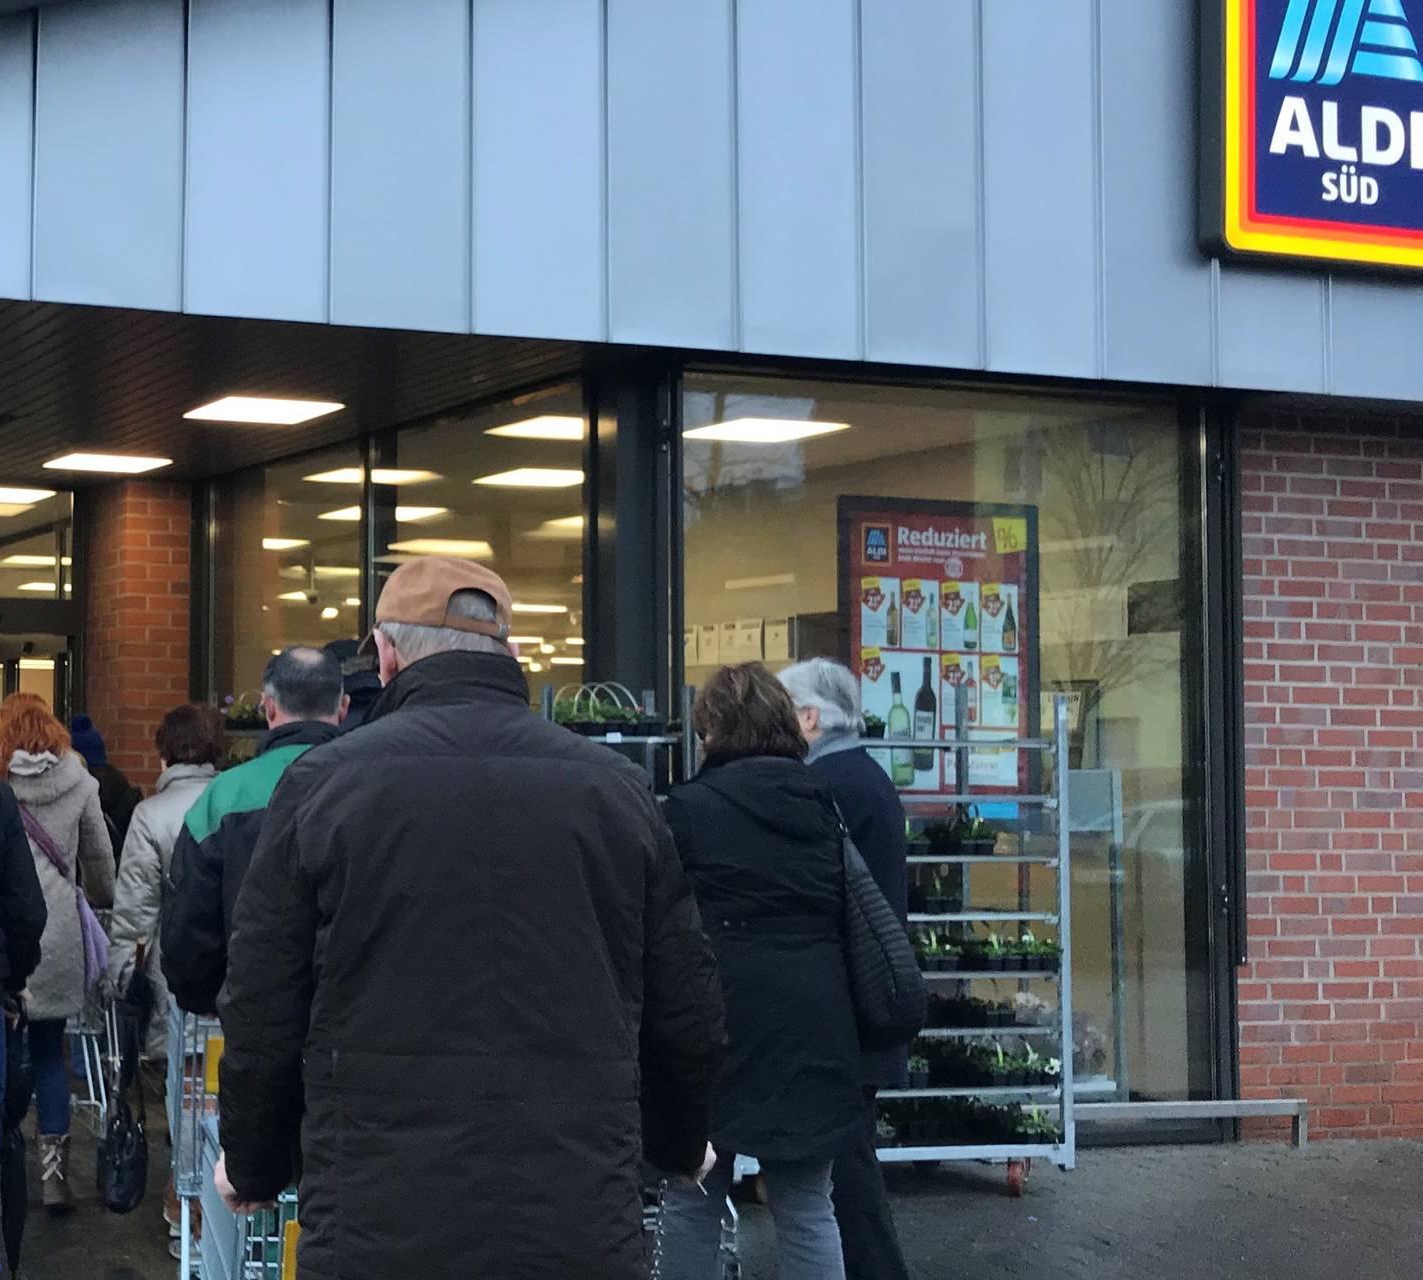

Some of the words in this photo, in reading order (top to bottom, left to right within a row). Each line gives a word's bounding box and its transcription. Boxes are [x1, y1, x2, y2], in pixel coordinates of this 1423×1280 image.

[1269, 95, 1423, 170] ALDI
[1321, 164, 1379, 206] SÜD
[897, 526, 987, 550] Reduziert
